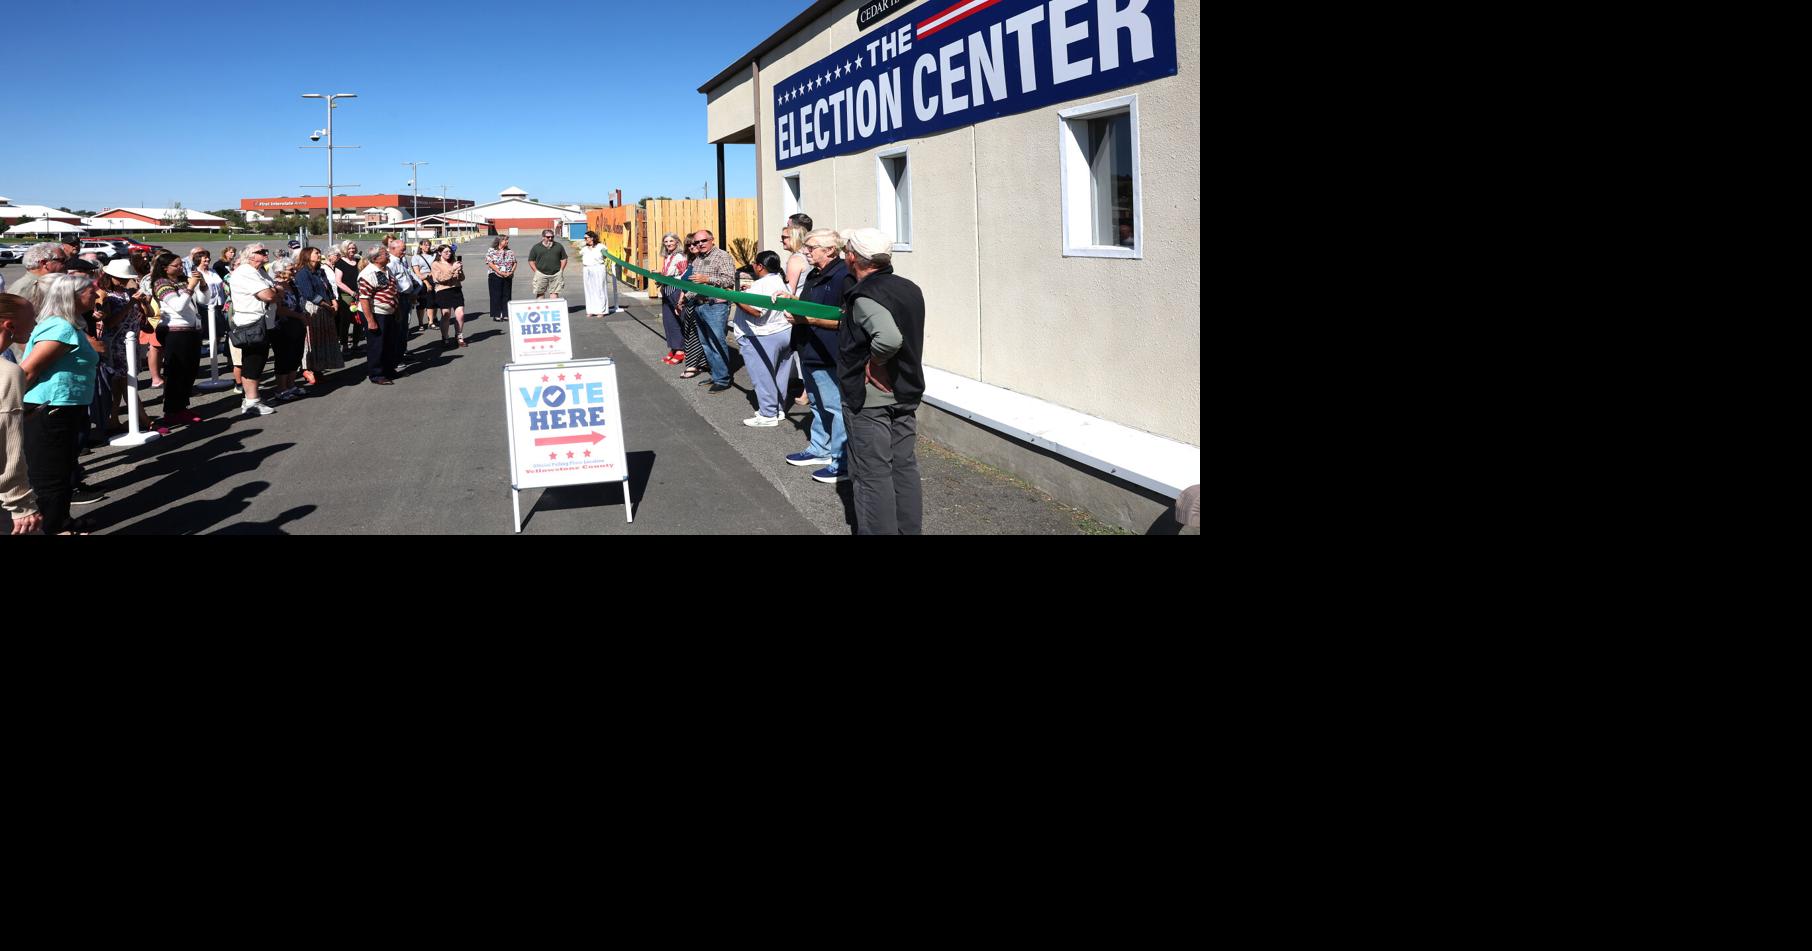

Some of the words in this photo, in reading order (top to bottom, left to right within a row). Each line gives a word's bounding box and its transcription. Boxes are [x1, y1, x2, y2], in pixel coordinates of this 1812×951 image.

[860, 0, 889, 23] CEDAR
[866, 23, 912, 68] THE
[778, 67, 902, 161] ELECTION
[912, 0, 1154, 123] CENTER
[516, 310, 561, 323] VOTE
[521, 323, 561, 335] HERE
[519, 382, 604, 408] VOTE
[528, 406, 605, 431] HERE
